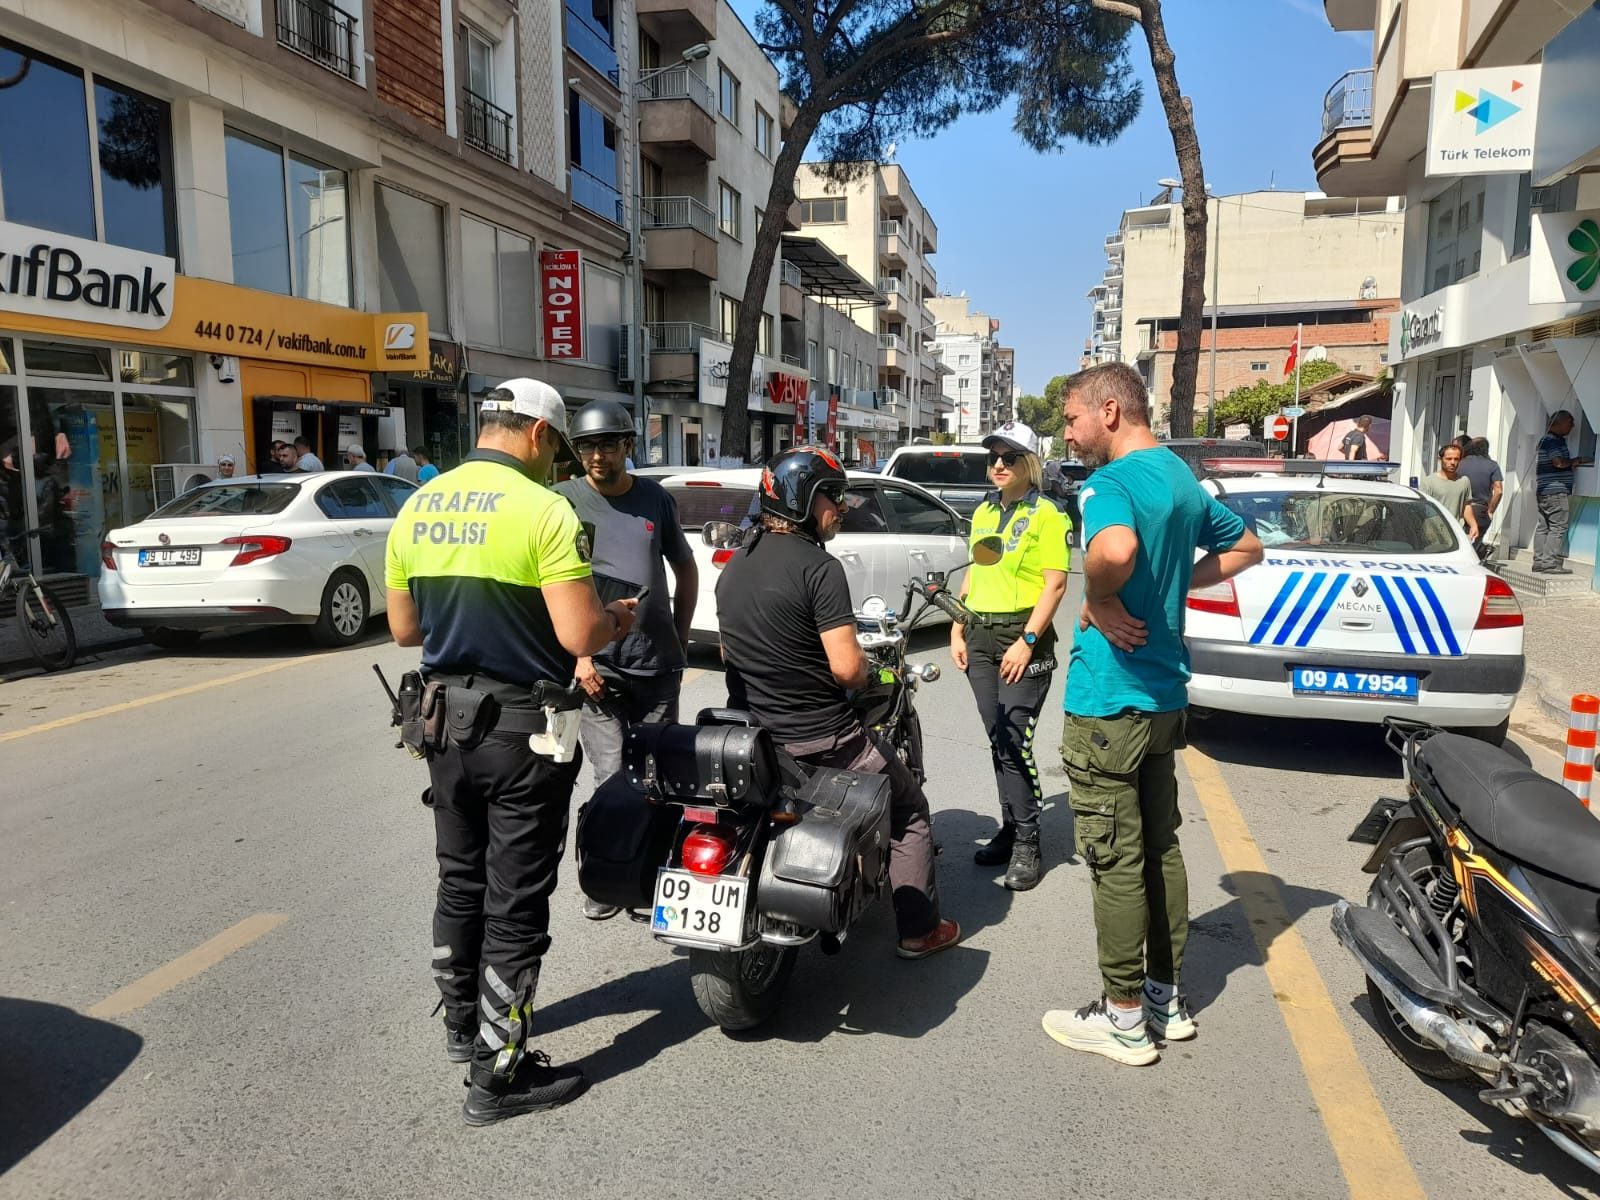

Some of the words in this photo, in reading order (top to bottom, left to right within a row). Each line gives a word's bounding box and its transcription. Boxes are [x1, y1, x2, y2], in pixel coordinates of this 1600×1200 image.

[1440, 149, 1469, 160] Türk
[1474, 147, 1531, 159] Telekom
[0, 244, 167, 317] ıfBank
[548, 276, 573, 356] NOTER
[195, 320, 222, 341] 444
[225, 324, 235, 341] 0
[238, 326, 263, 346] 724
[278, 332, 367, 360] vakifbank.com.tr
[180, 550, 198, 561] 495
[1258, 557, 1349, 569] RAFIK
[1301, 670, 1327, 688] 09
[1332, 672, 1349, 690] A
[1355, 673, 1408, 693] 7954
[662, 877, 691, 901] 09
[711, 883, 740, 908] UM
[680, 907, 722, 934] 138
